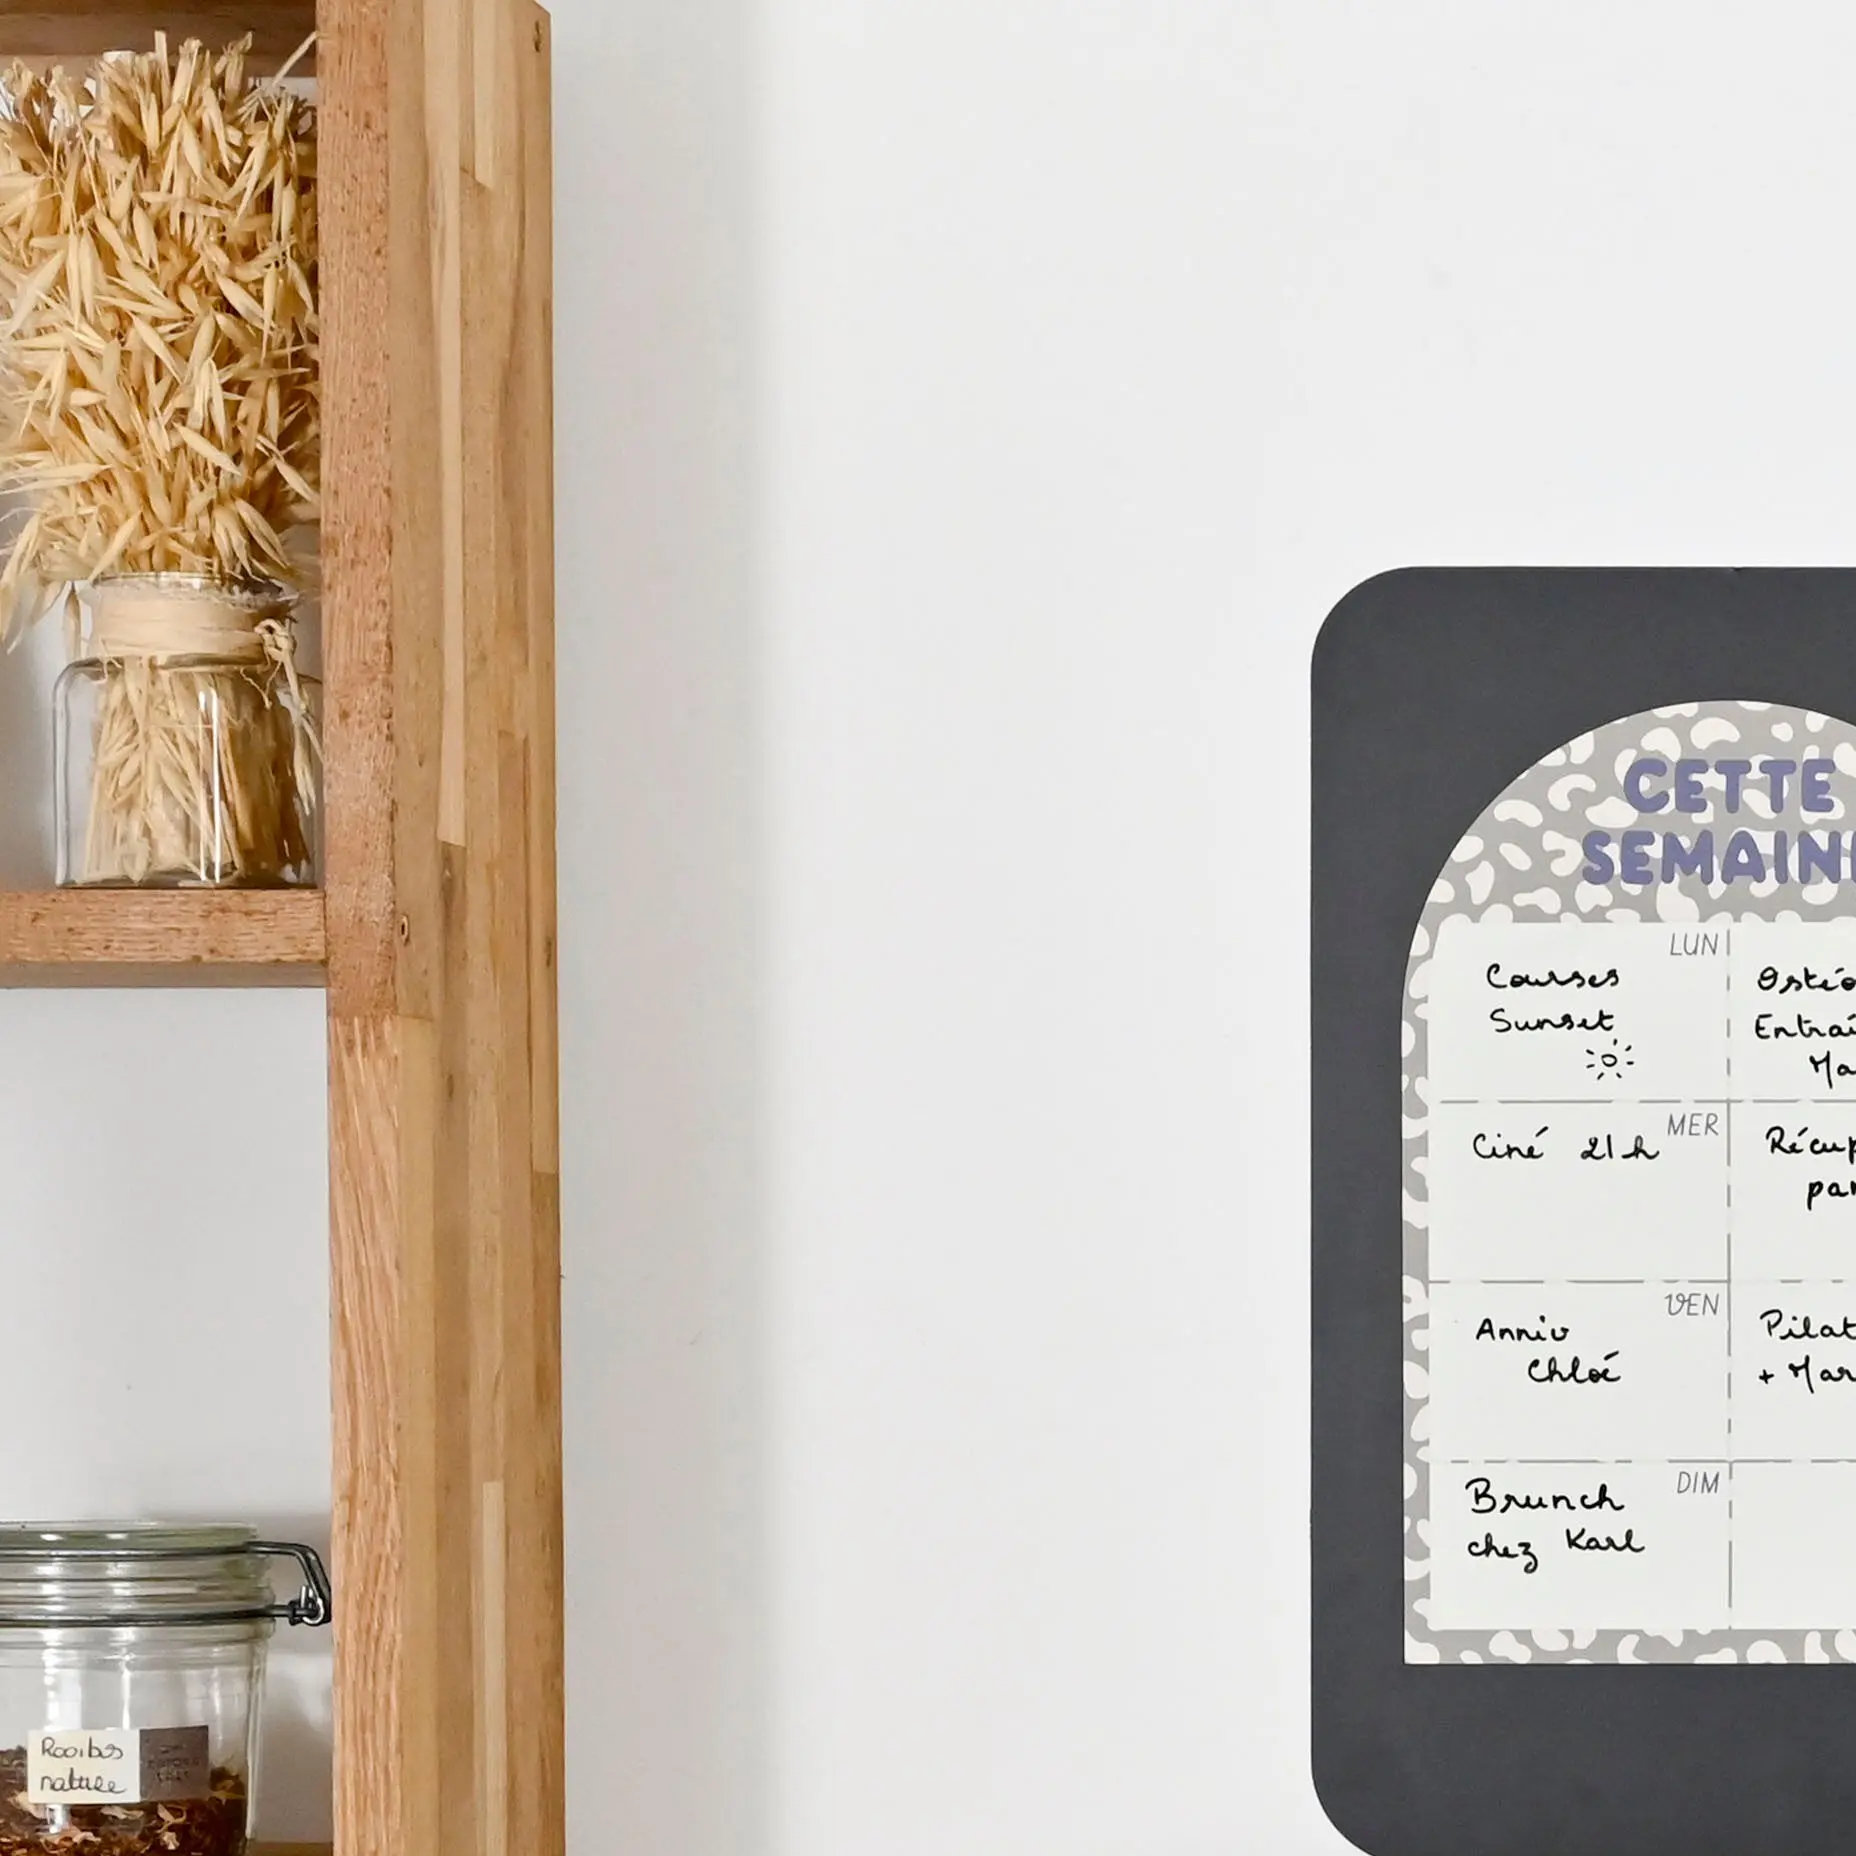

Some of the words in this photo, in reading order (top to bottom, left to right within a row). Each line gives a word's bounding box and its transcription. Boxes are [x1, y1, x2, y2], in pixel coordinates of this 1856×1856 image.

[1623, 757, 1837, 813] CETTE
[1669, 932, 1719, 957] LUN
[1486, 962, 1620, 990] Courses
[1489, 1007, 1615, 1034] Sunset
[1666, 1112, 1720, 1137] MER
[1472, 1125, 1549, 1160] Ciné
[1663, 1292, 1720, 1317] VEN
[1475, 1314, 1570, 1342] Anniv
[1527, 1350, 1622, 1385] Chloé
[1758, 1368, 1775, 1385] +
[1464, 1477, 1625, 1515] Brunch
[1676, 1470, 1721, 1495] DIM
[1467, 1532, 1539, 1575] chez
[1565, 1527, 1646, 1554] Karl
[41, 1736, 124, 1760] Rooibos
